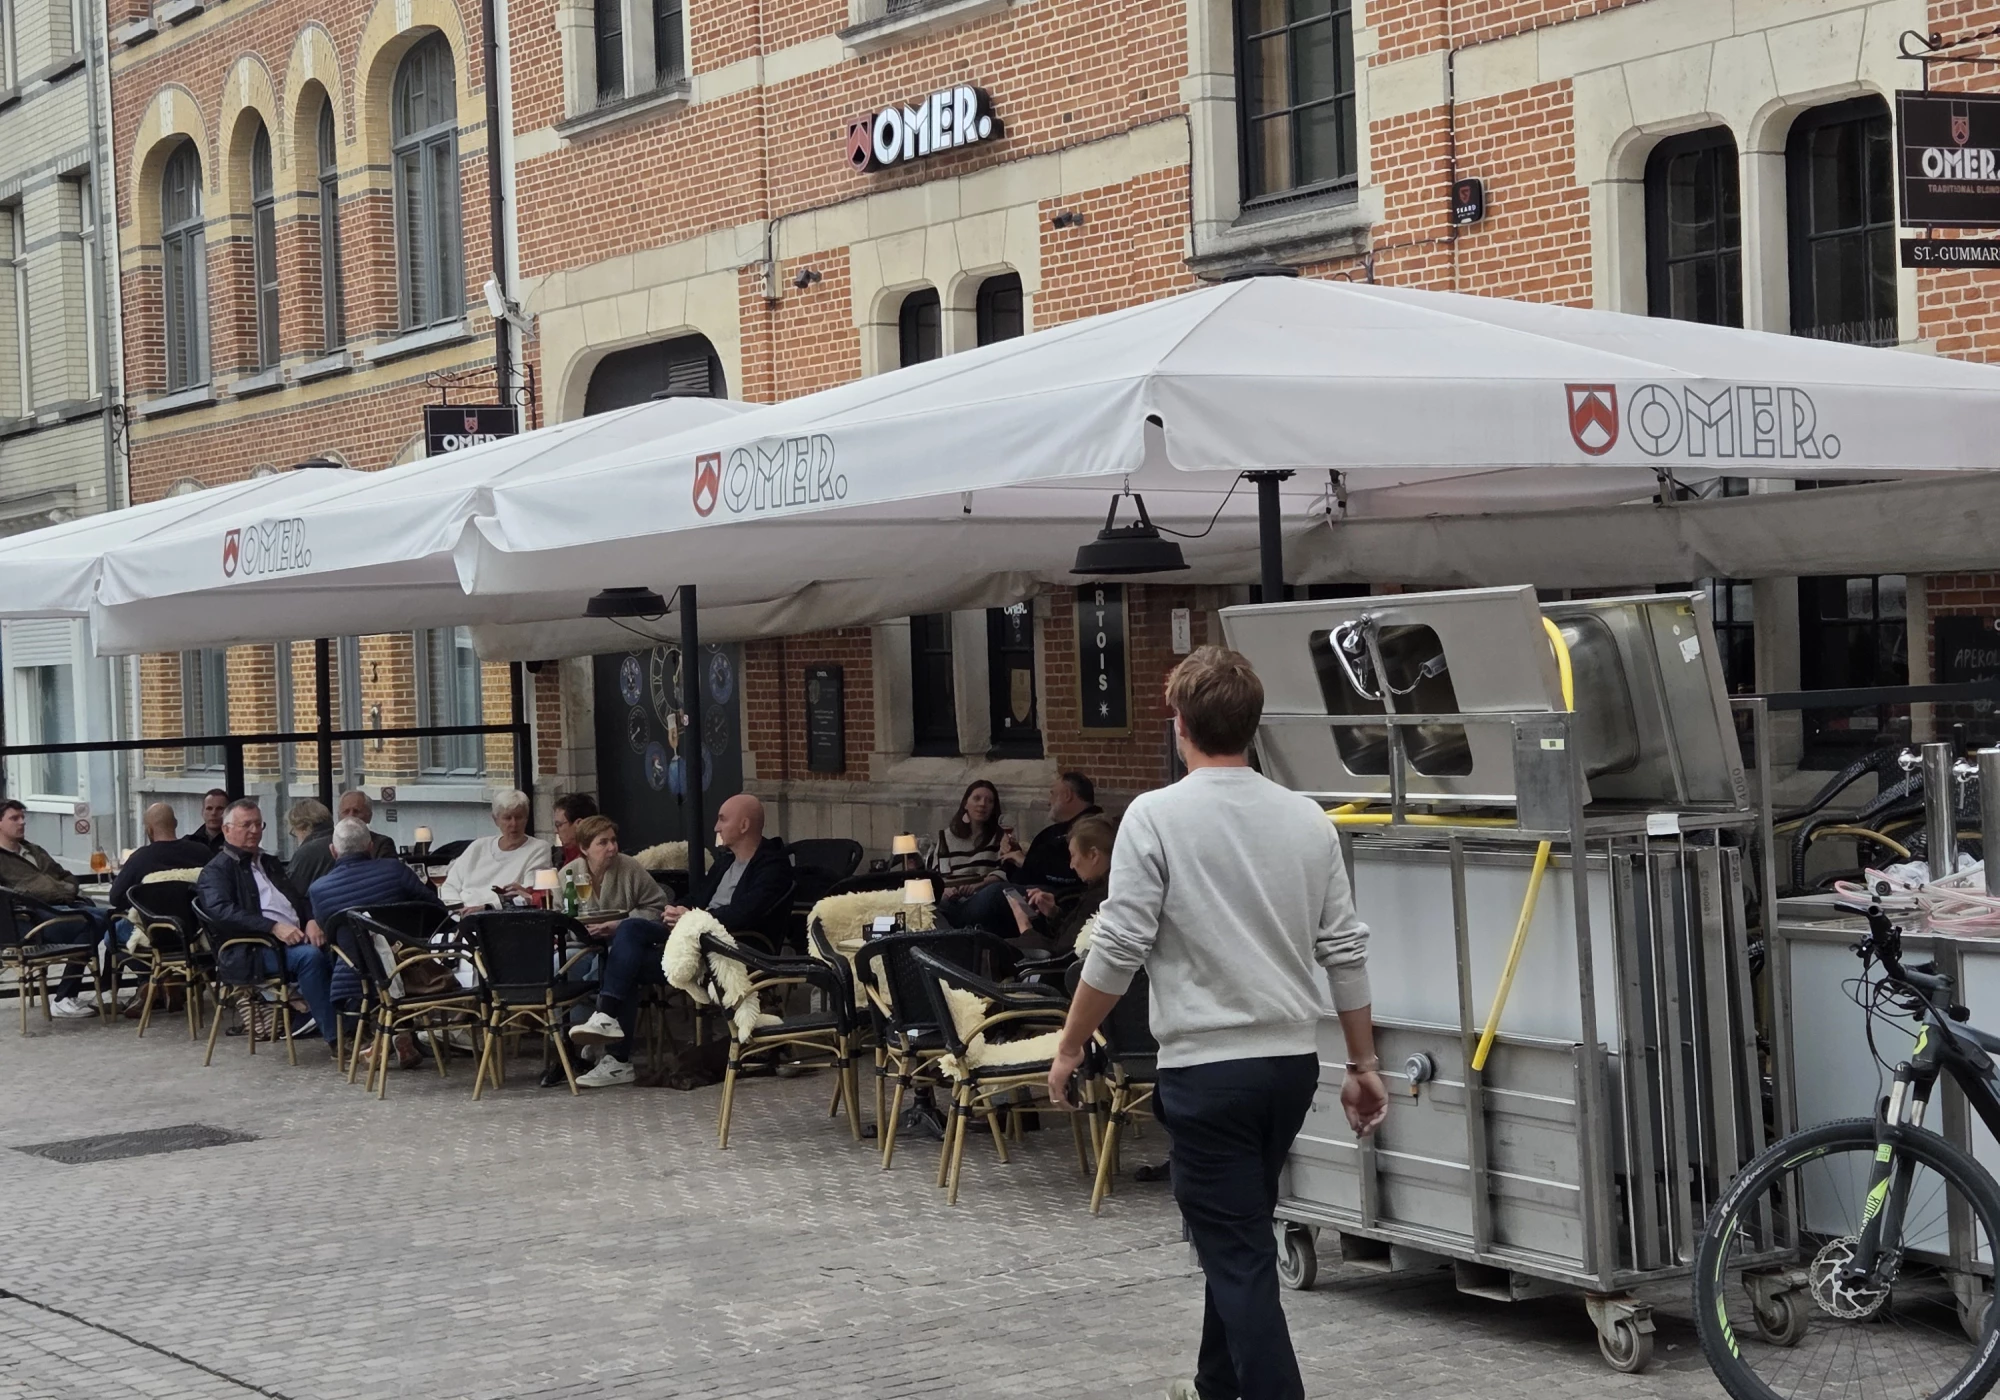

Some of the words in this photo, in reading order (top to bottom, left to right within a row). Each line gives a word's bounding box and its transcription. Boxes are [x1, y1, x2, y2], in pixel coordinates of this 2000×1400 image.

[1928, 184, 1975, 194] TRADITIONAL
[1913, 246, 2000, 261] ST.-GUMMAR
[1095, 581, 1108, 692] RTOIS
